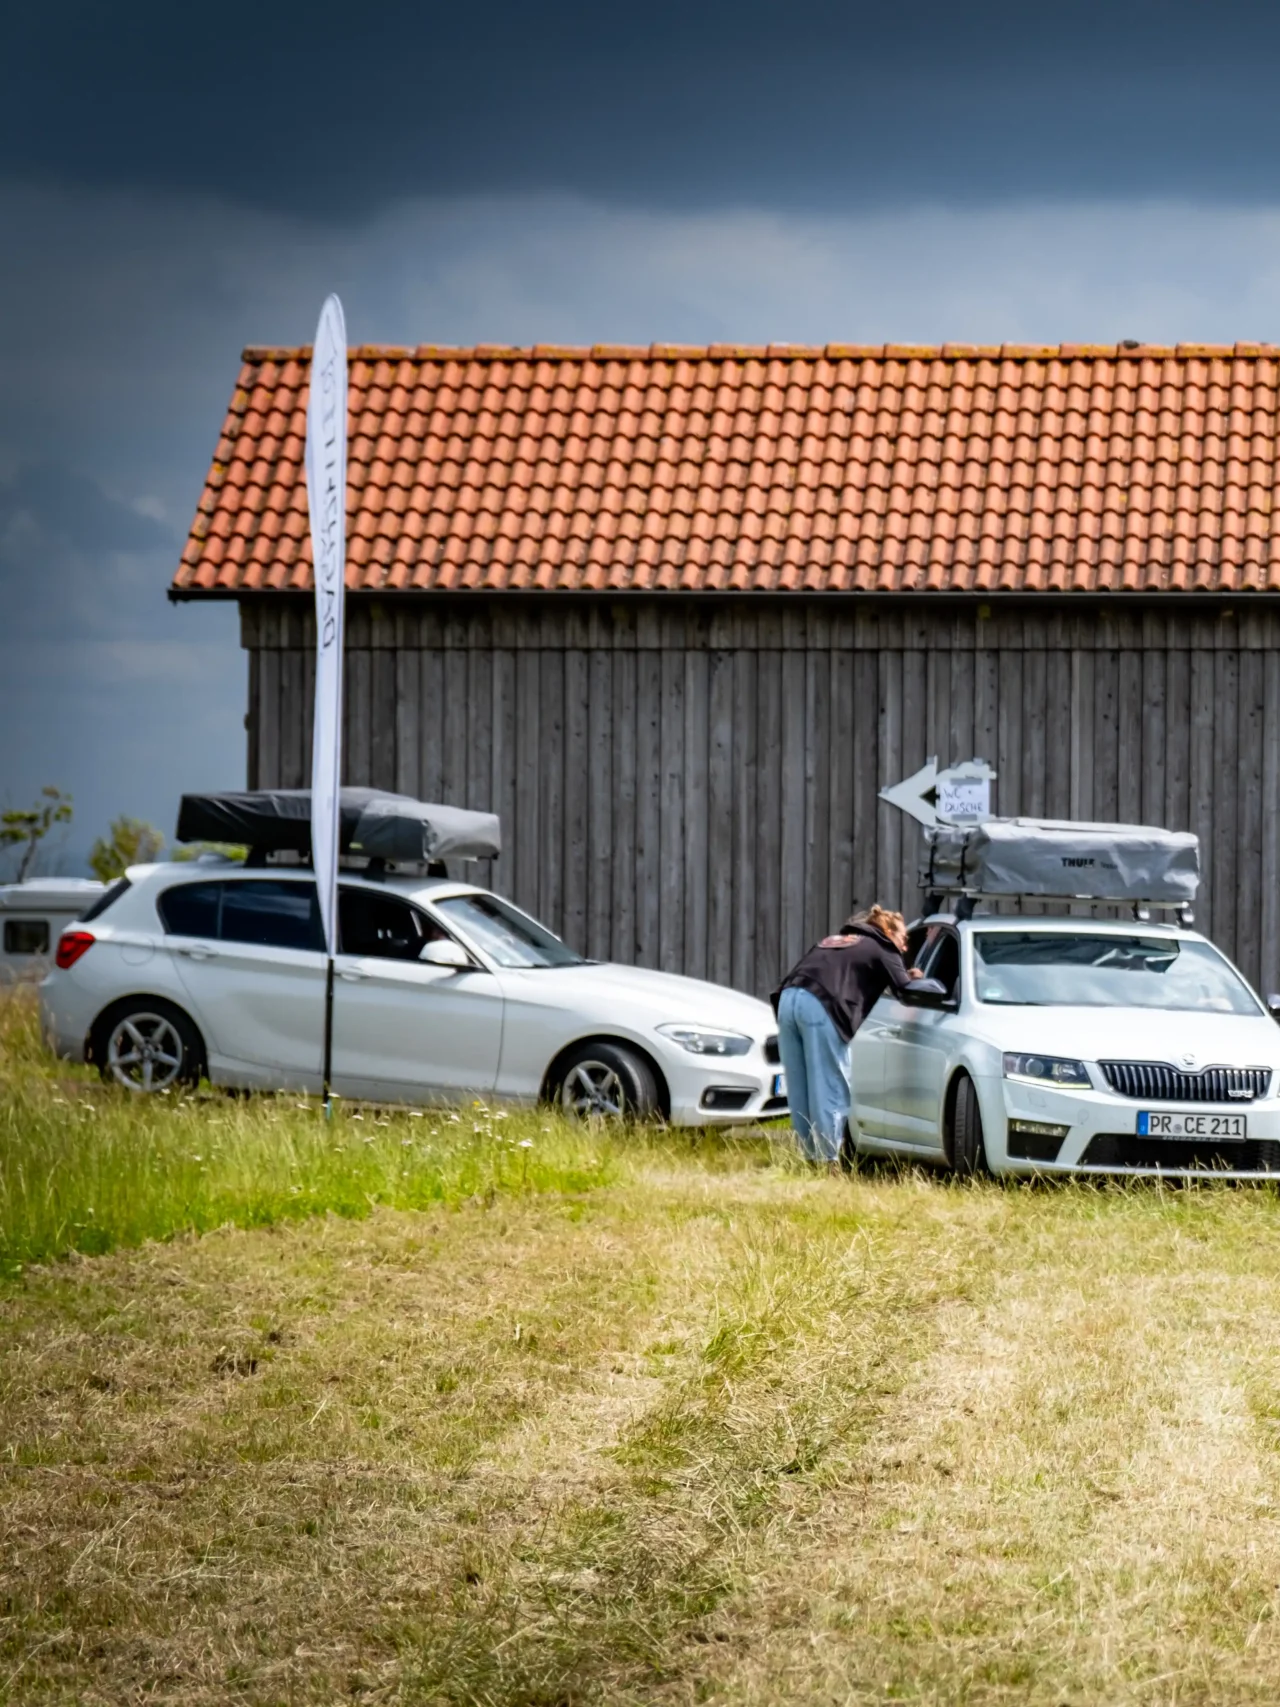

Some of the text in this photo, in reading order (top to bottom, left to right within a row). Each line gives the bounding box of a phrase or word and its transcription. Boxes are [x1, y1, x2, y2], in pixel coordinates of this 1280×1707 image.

[943, 786, 961, 799] WC
[944, 802, 984, 813] DUSCHE
[1149, 1115, 1242, 1136] PR CE 211
